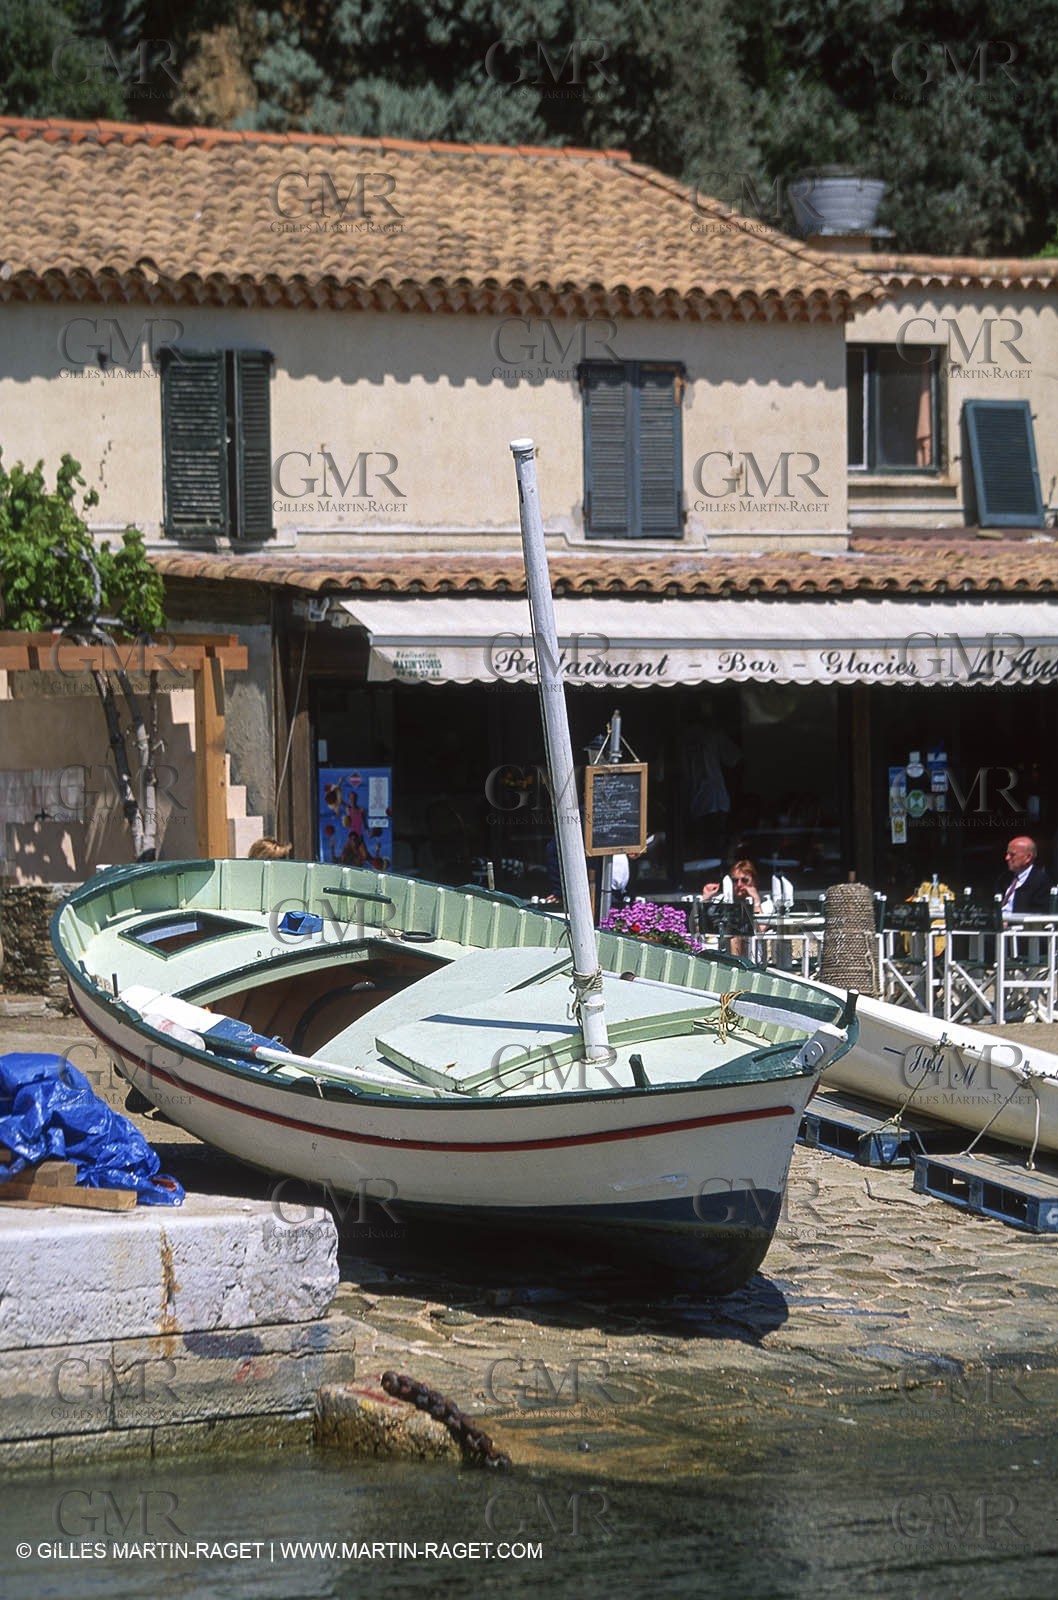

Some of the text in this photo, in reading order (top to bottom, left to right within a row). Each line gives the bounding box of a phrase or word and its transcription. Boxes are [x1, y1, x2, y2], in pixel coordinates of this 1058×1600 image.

[495, 648, 669, 677] Retaurant
[718, 652, 779, 673] Bar
[820, 650, 919, 677] Glacier
[909, 1045, 944, 1074] Just
